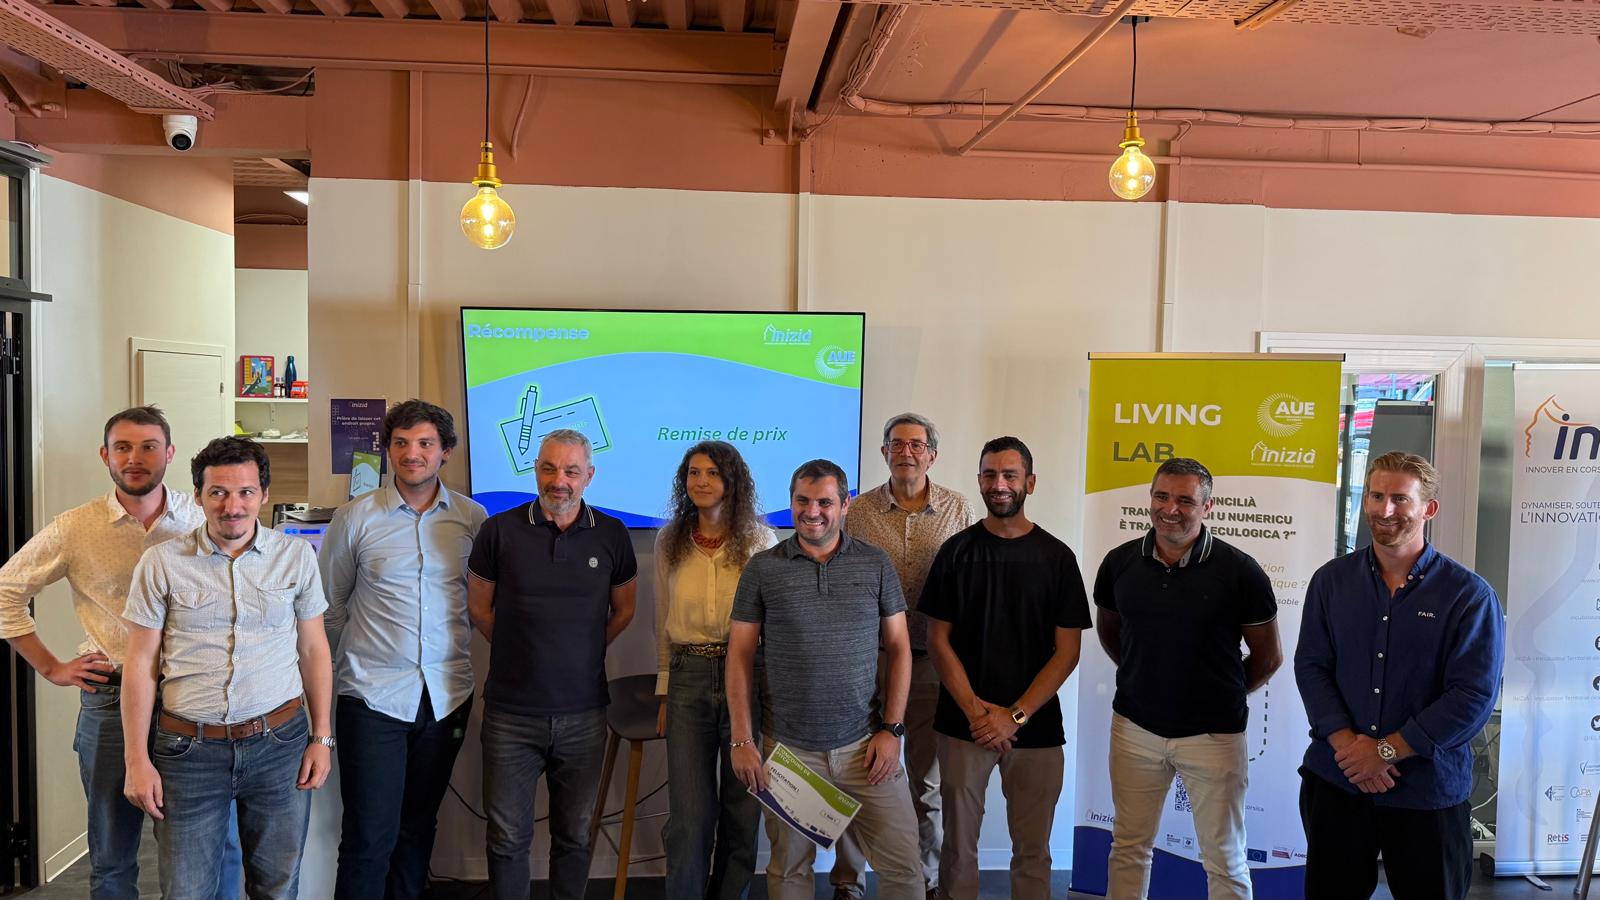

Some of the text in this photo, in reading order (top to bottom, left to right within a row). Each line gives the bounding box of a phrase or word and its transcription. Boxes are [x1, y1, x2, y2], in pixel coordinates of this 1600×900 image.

[468, 323, 590, 341] Récompense
[828, 351, 856, 362] AUE
[1114, 402, 1222, 427] LIVING
[1275, 401, 1315, 416] AUE
[657, 426, 788, 444] Remise de prix
[1113, 441, 1175, 463] LAB
[1566, 466, 1578, 474] EN
[1213, 496, 1257, 507] NCILIÀ
[1121, 506, 1151, 516] TRAN
[1217, 512, 1225, 521] U
[1228, 512, 1292, 524] NUMERICU
[1521, 512, 1600, 523] L'INNOVATI
[1129, 521, 1152, 531] TRA
[1210, 526, 1280, 540] ECULOGICA
